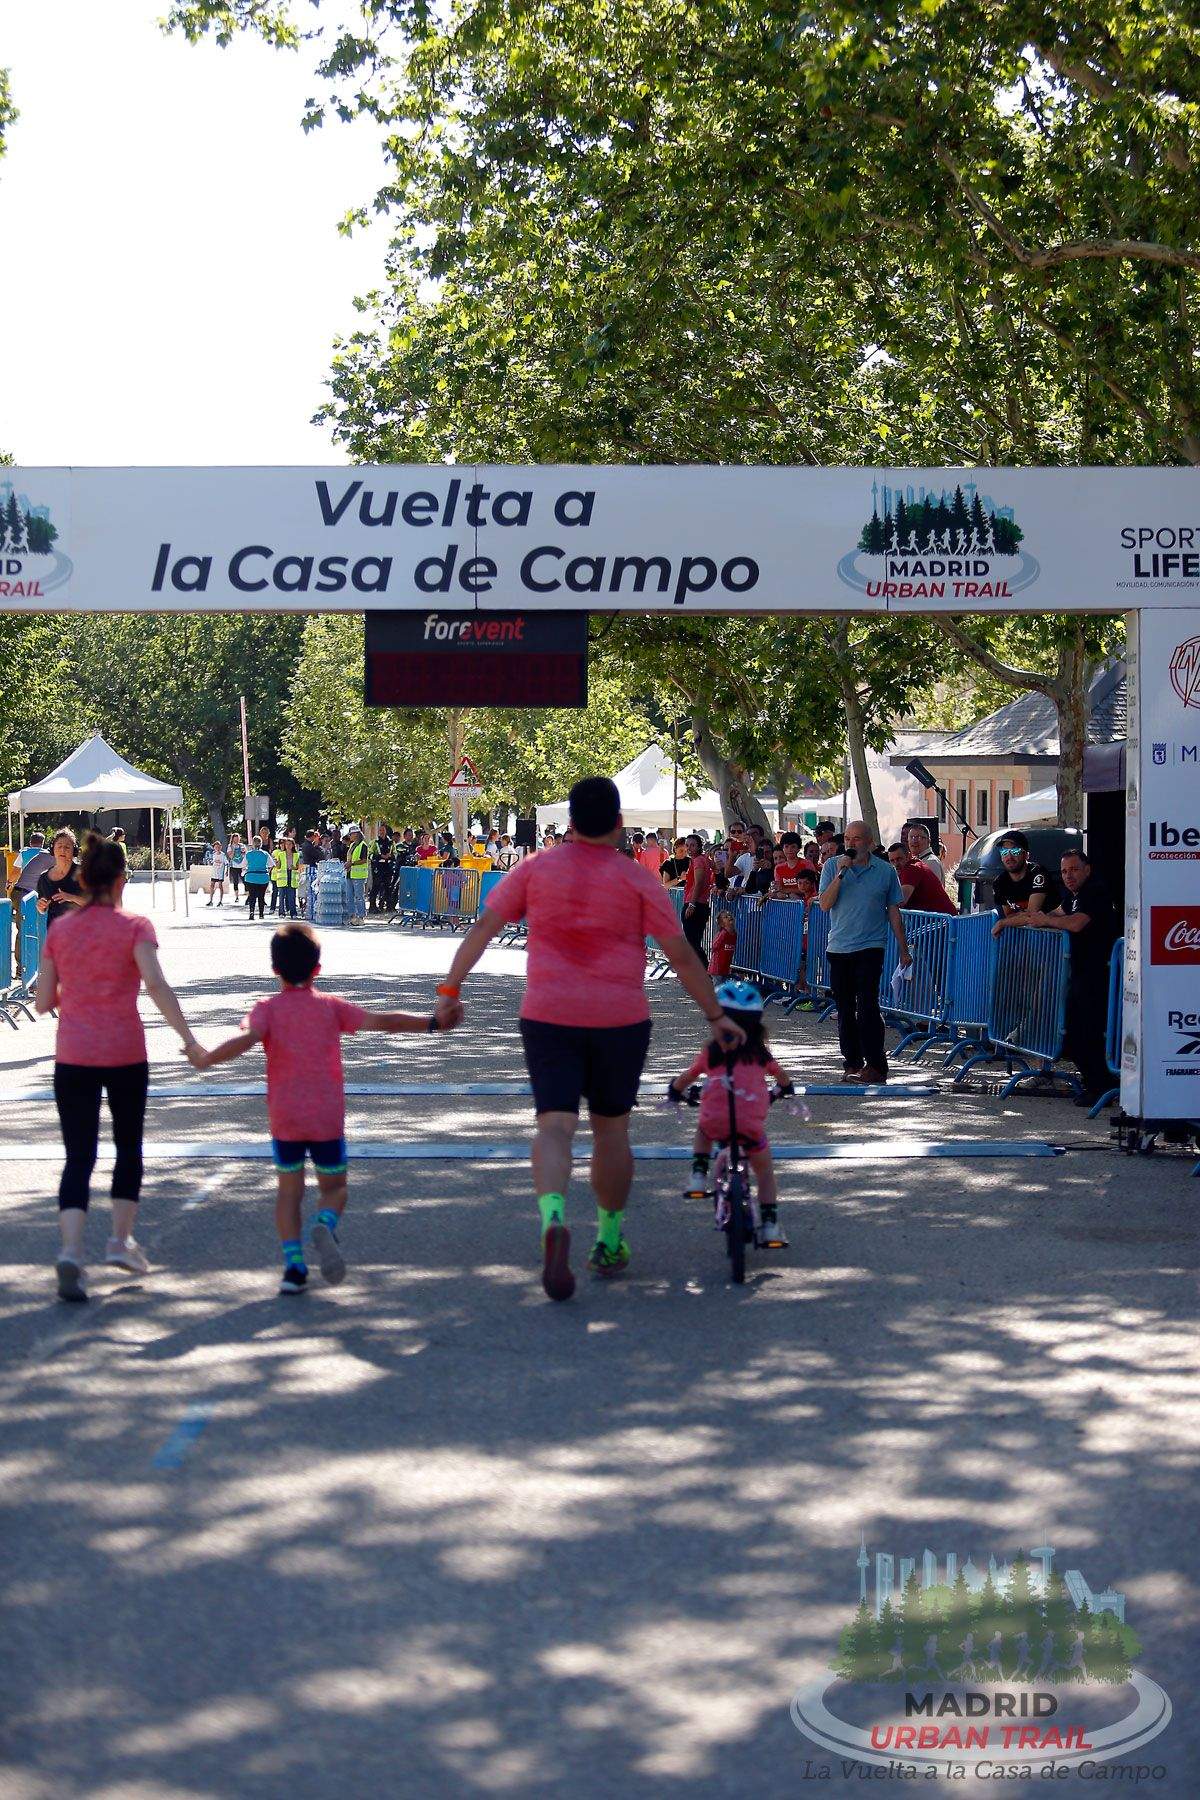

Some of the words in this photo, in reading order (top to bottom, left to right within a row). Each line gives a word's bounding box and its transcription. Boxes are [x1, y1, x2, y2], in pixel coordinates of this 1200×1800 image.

[315, 479, 534, 527] Vuelta
[553, 489, 597, 527] a
[151, 543, 212, 592] la
[228, 545, 393, 592] Casa
[413, 544, 498, 592] de
[519, 545, 760, 604] Campo
[889, 560, 990, 577] MADRID
[1134, 553, 1200, 577] LIFE
[865, 582, 946, 598] URBAN
[952, 581, 1013, 598] TRAIL
[423, 613, 525, 640] forevent
[1168, 1011, 1200, 1029] Re
